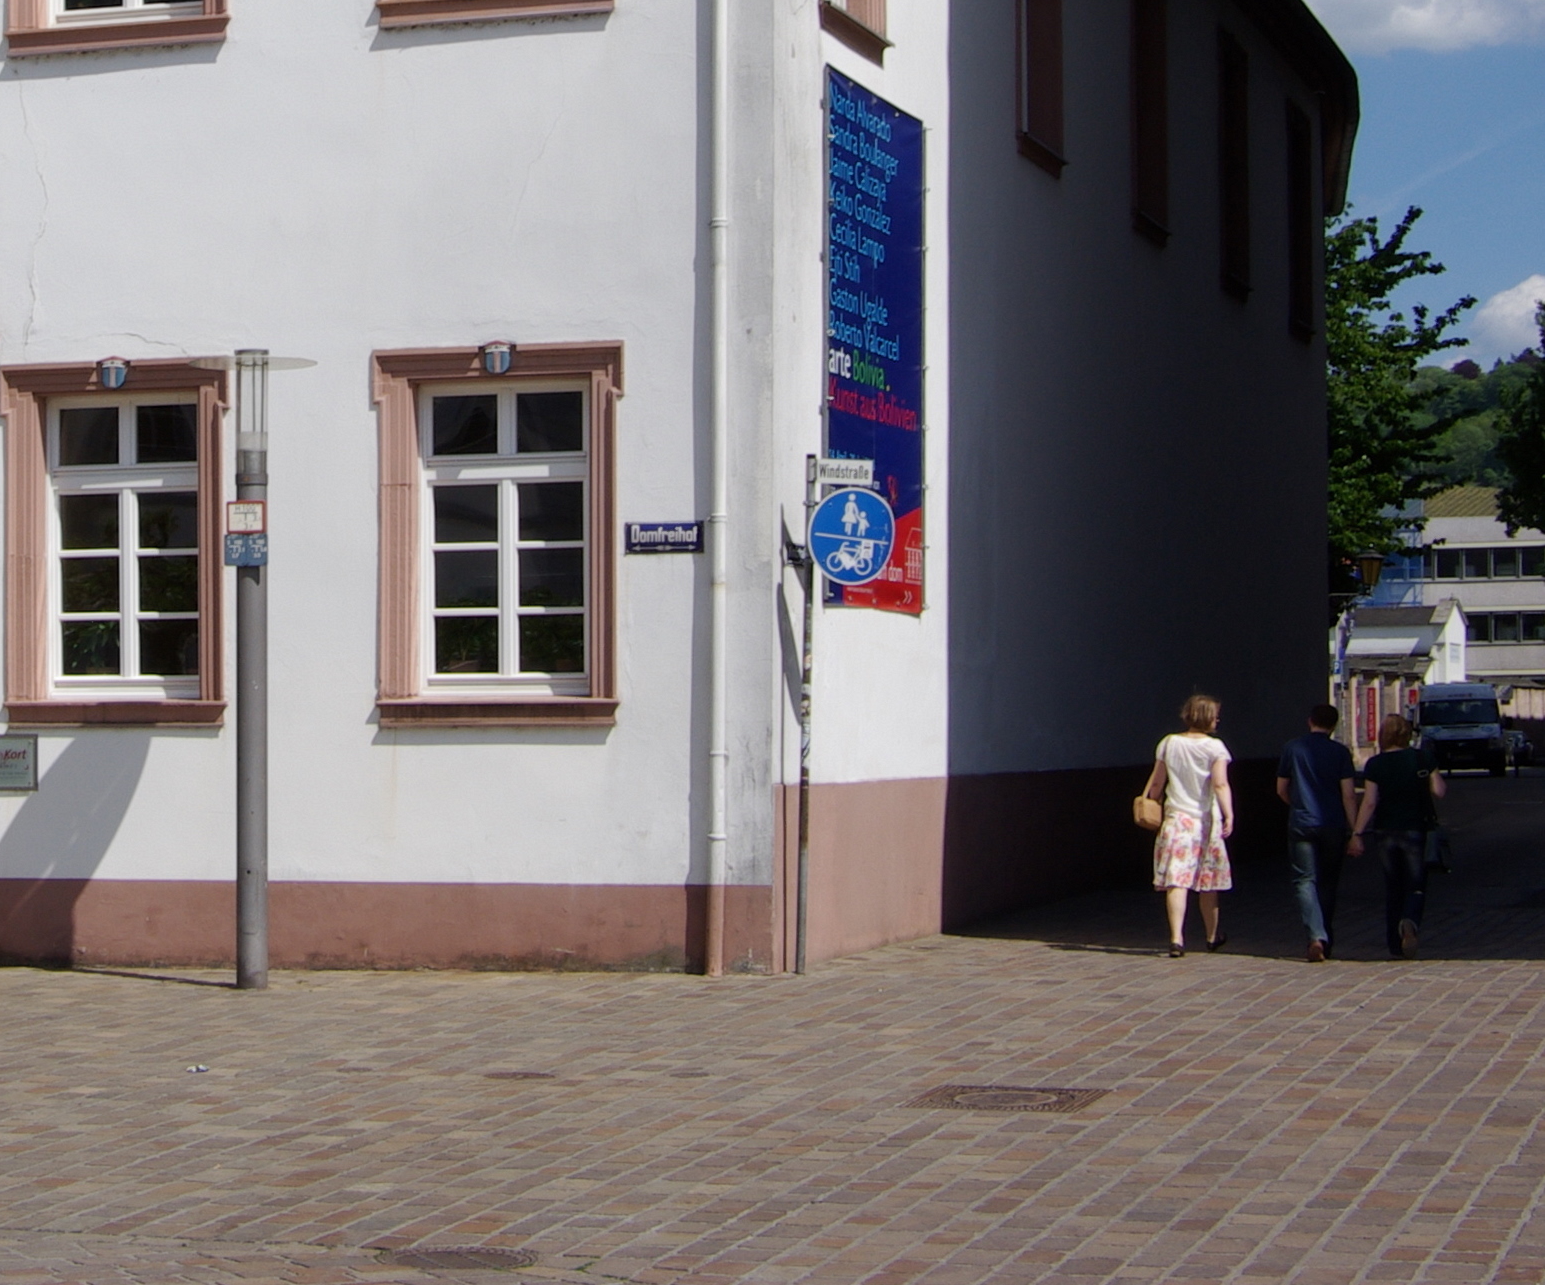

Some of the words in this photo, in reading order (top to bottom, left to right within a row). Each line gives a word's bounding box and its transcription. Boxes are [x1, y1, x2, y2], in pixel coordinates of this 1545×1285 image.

[829, 82, 855, 122] Narda
[857, 100, 891, 142] Alvarado
[829, 114, 858, 155] Sandra
[860, 132, 899, 183] Boulanger
[829, 148, 853, 184] Jaime
[829, 213, 856, 250] Cecilia
[858, 226, 884, 269] Lampo
[829, 310, 863, 348] Roberto
[860, 290, 888, 330] Ugalde
[829, 347, 852, 379] arte
[829, 375, 858, 415] Kunst
[860, 396, 876, 421] aus
[878, 392, 917, 433] Bolivien
[819, 464, 870, 480] Windstraße
[631, 524, 698, 544] Domfreihof
